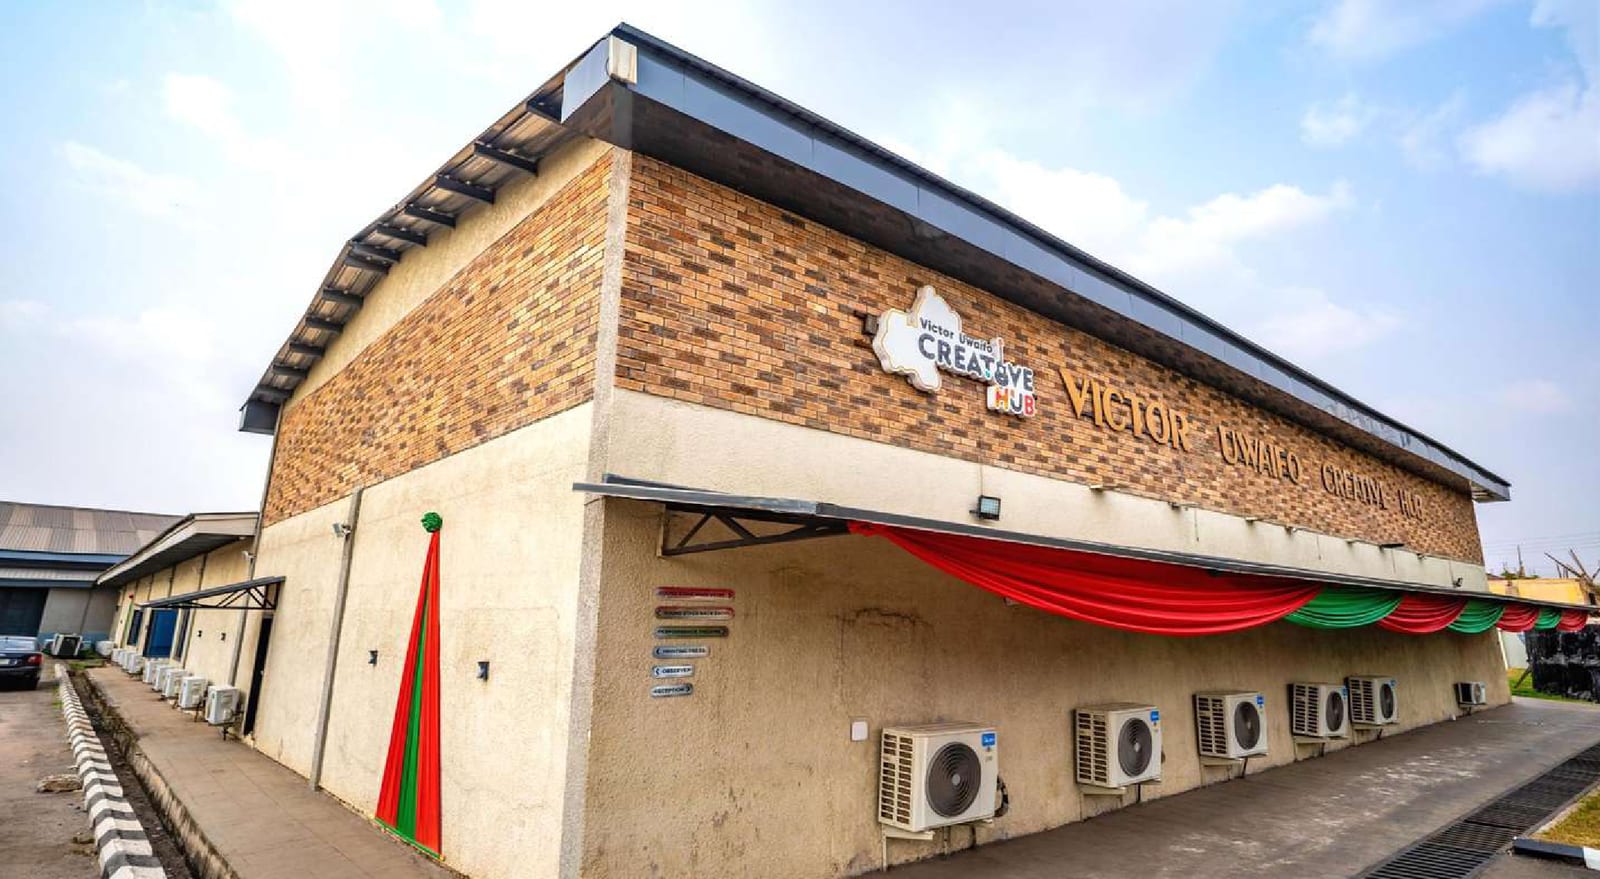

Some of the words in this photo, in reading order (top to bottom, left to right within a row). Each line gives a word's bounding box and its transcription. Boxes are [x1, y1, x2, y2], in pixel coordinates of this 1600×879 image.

[920, 317, 955, 340] Victor
[959, 333, 993, 354] Uwaifo
[995, 388, 1036, 416] HUB
[1059, 367, 1193, 453] VICTOR
[1217, 425, 1304, 485] UWAIFO
